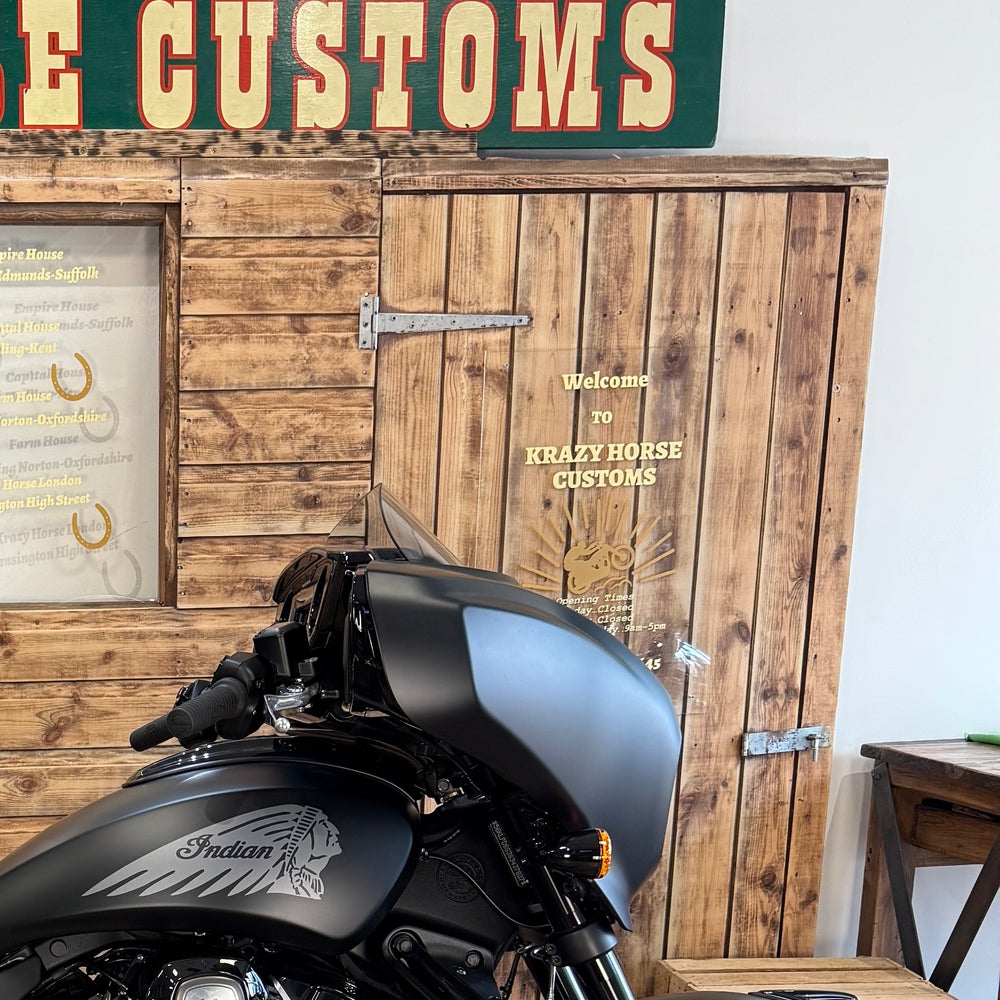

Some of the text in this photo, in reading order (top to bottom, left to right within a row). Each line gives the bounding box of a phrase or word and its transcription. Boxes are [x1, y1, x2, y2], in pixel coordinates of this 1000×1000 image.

[136, 0, 676, 131] CUSTOMS
[25, 249, 64, 260] House
[23, 321, 61, 333] House
[562, 371, 649, 391] Welcome
[16, 391, 52, 403] House
[591, 411, 613, 424] TO
[525, 441, 683, 465] KRAZY HORSE
[2, 479, 37, 490] Horse
[38, 475, 82, 488] London
[552, 468, 657, 490] CUSTOMS
[26, 496, 54, 510] High
[56, 493, 91, 506] Street
[556, 594, 634, 606] Opening Times
[176, 833, 273, 860] Indian
